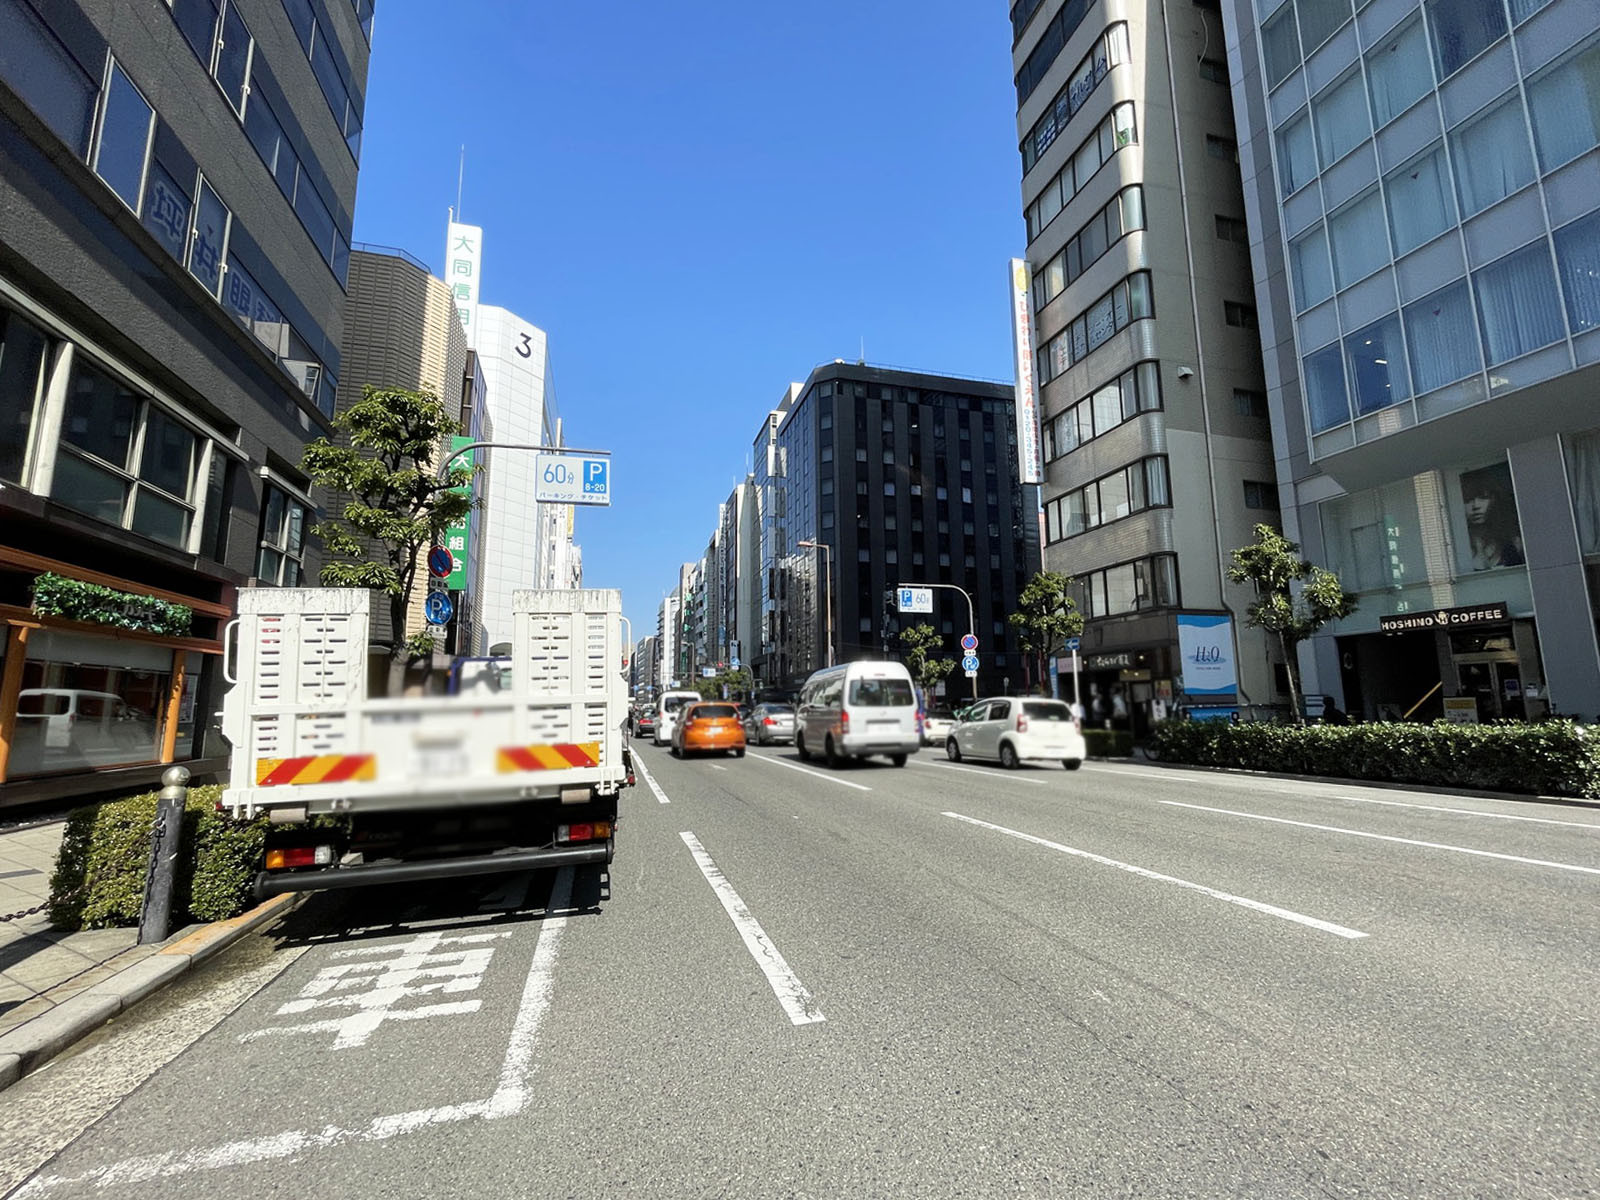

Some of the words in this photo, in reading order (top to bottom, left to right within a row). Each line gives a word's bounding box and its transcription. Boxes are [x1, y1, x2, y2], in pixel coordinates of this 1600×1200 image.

[514, 331, 532, 359] 3
[543, 463, 575, 485] 60分
[590, 463, 603, 481] P
[585, 483, 605, 492] 8-20
[1381, 617, 1434, 631] HOSHINO
[1450, 609, 1503, 623] COFFEE
